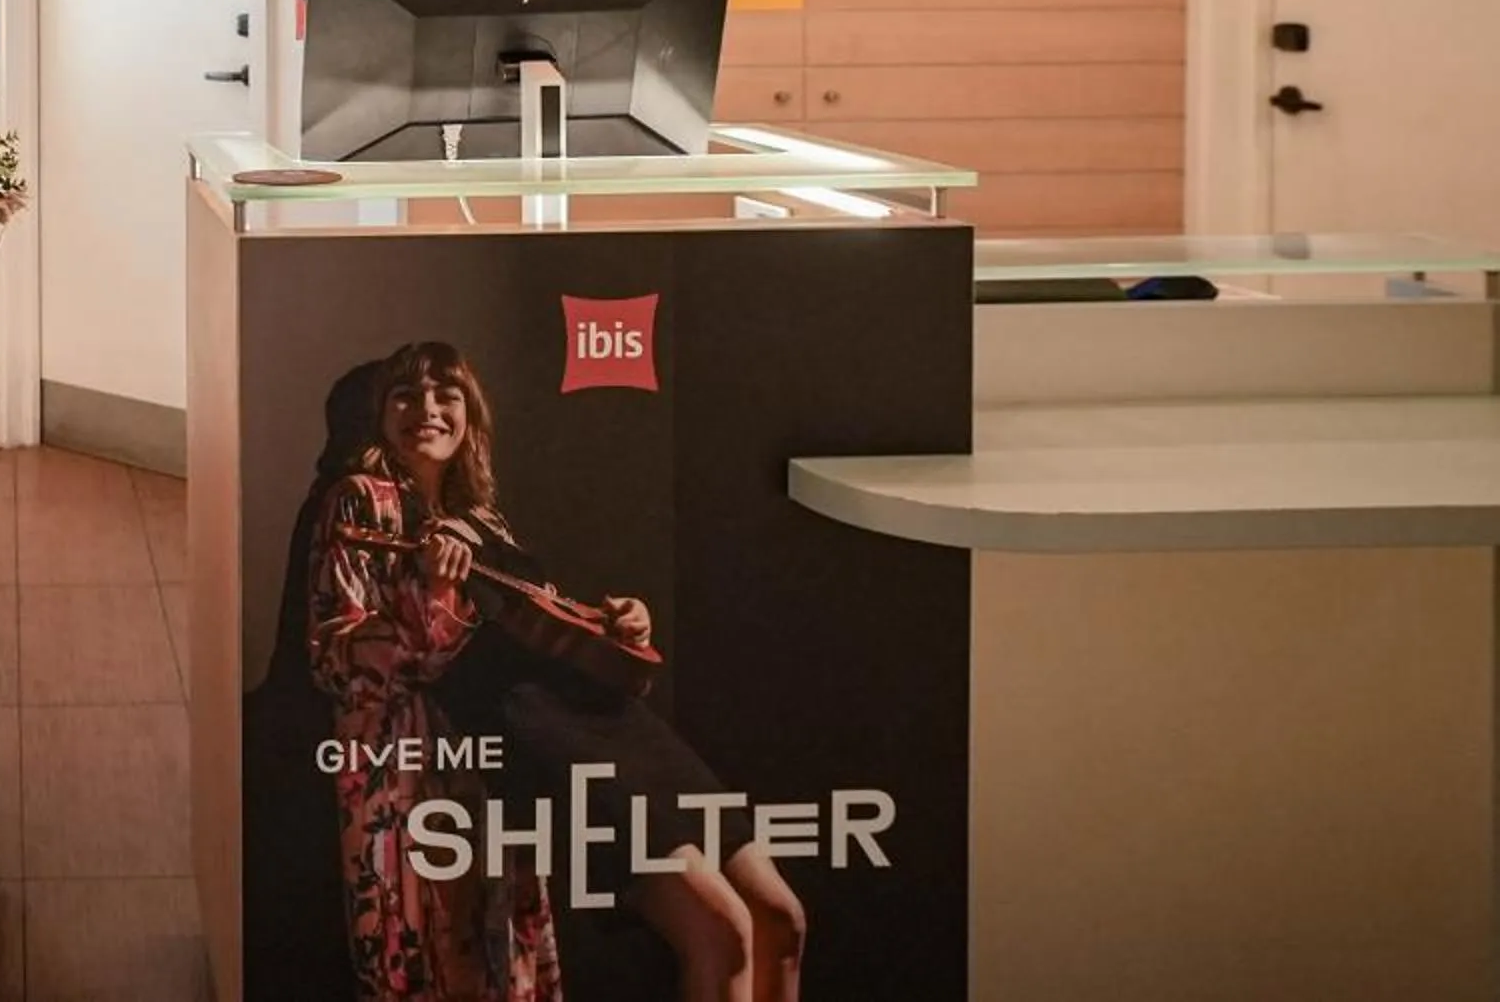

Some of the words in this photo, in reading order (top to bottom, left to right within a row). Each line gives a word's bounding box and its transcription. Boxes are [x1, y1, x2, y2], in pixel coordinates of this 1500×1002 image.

[577, 320, 644, 359] ibis
[315, 737, 423, 774] GIVE
[437, 736, 504, 770] ME
[406, 762, 897, 909] SHELTER
